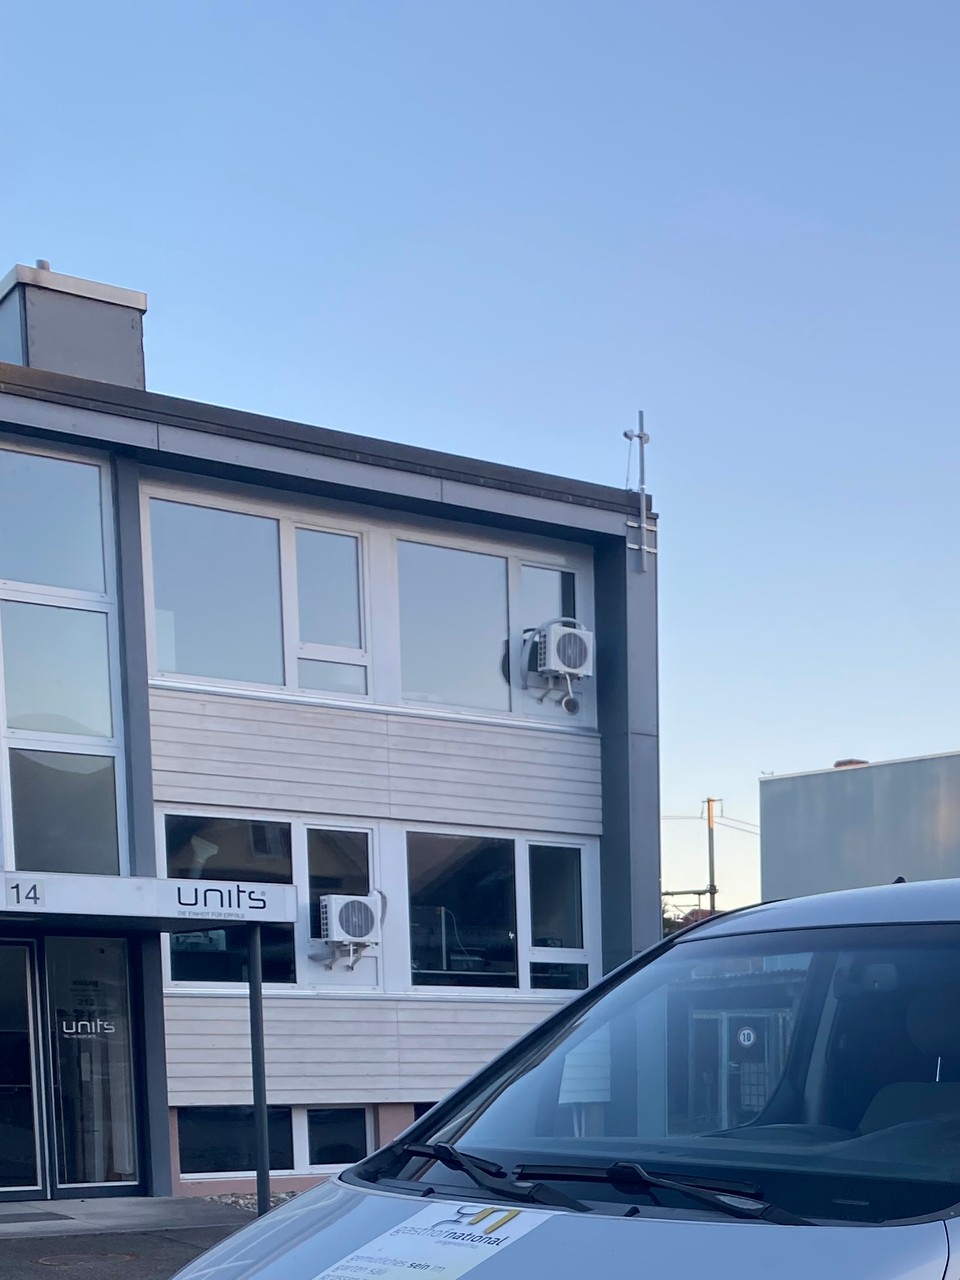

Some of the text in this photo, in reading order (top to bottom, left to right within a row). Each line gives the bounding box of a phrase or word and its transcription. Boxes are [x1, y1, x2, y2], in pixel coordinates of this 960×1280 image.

[10, 883, 40, 905] 14
[177, 884, 266, 909] units
[62, 1018, 116, 1033] units
[407, 1261, 431, 1271] sein
